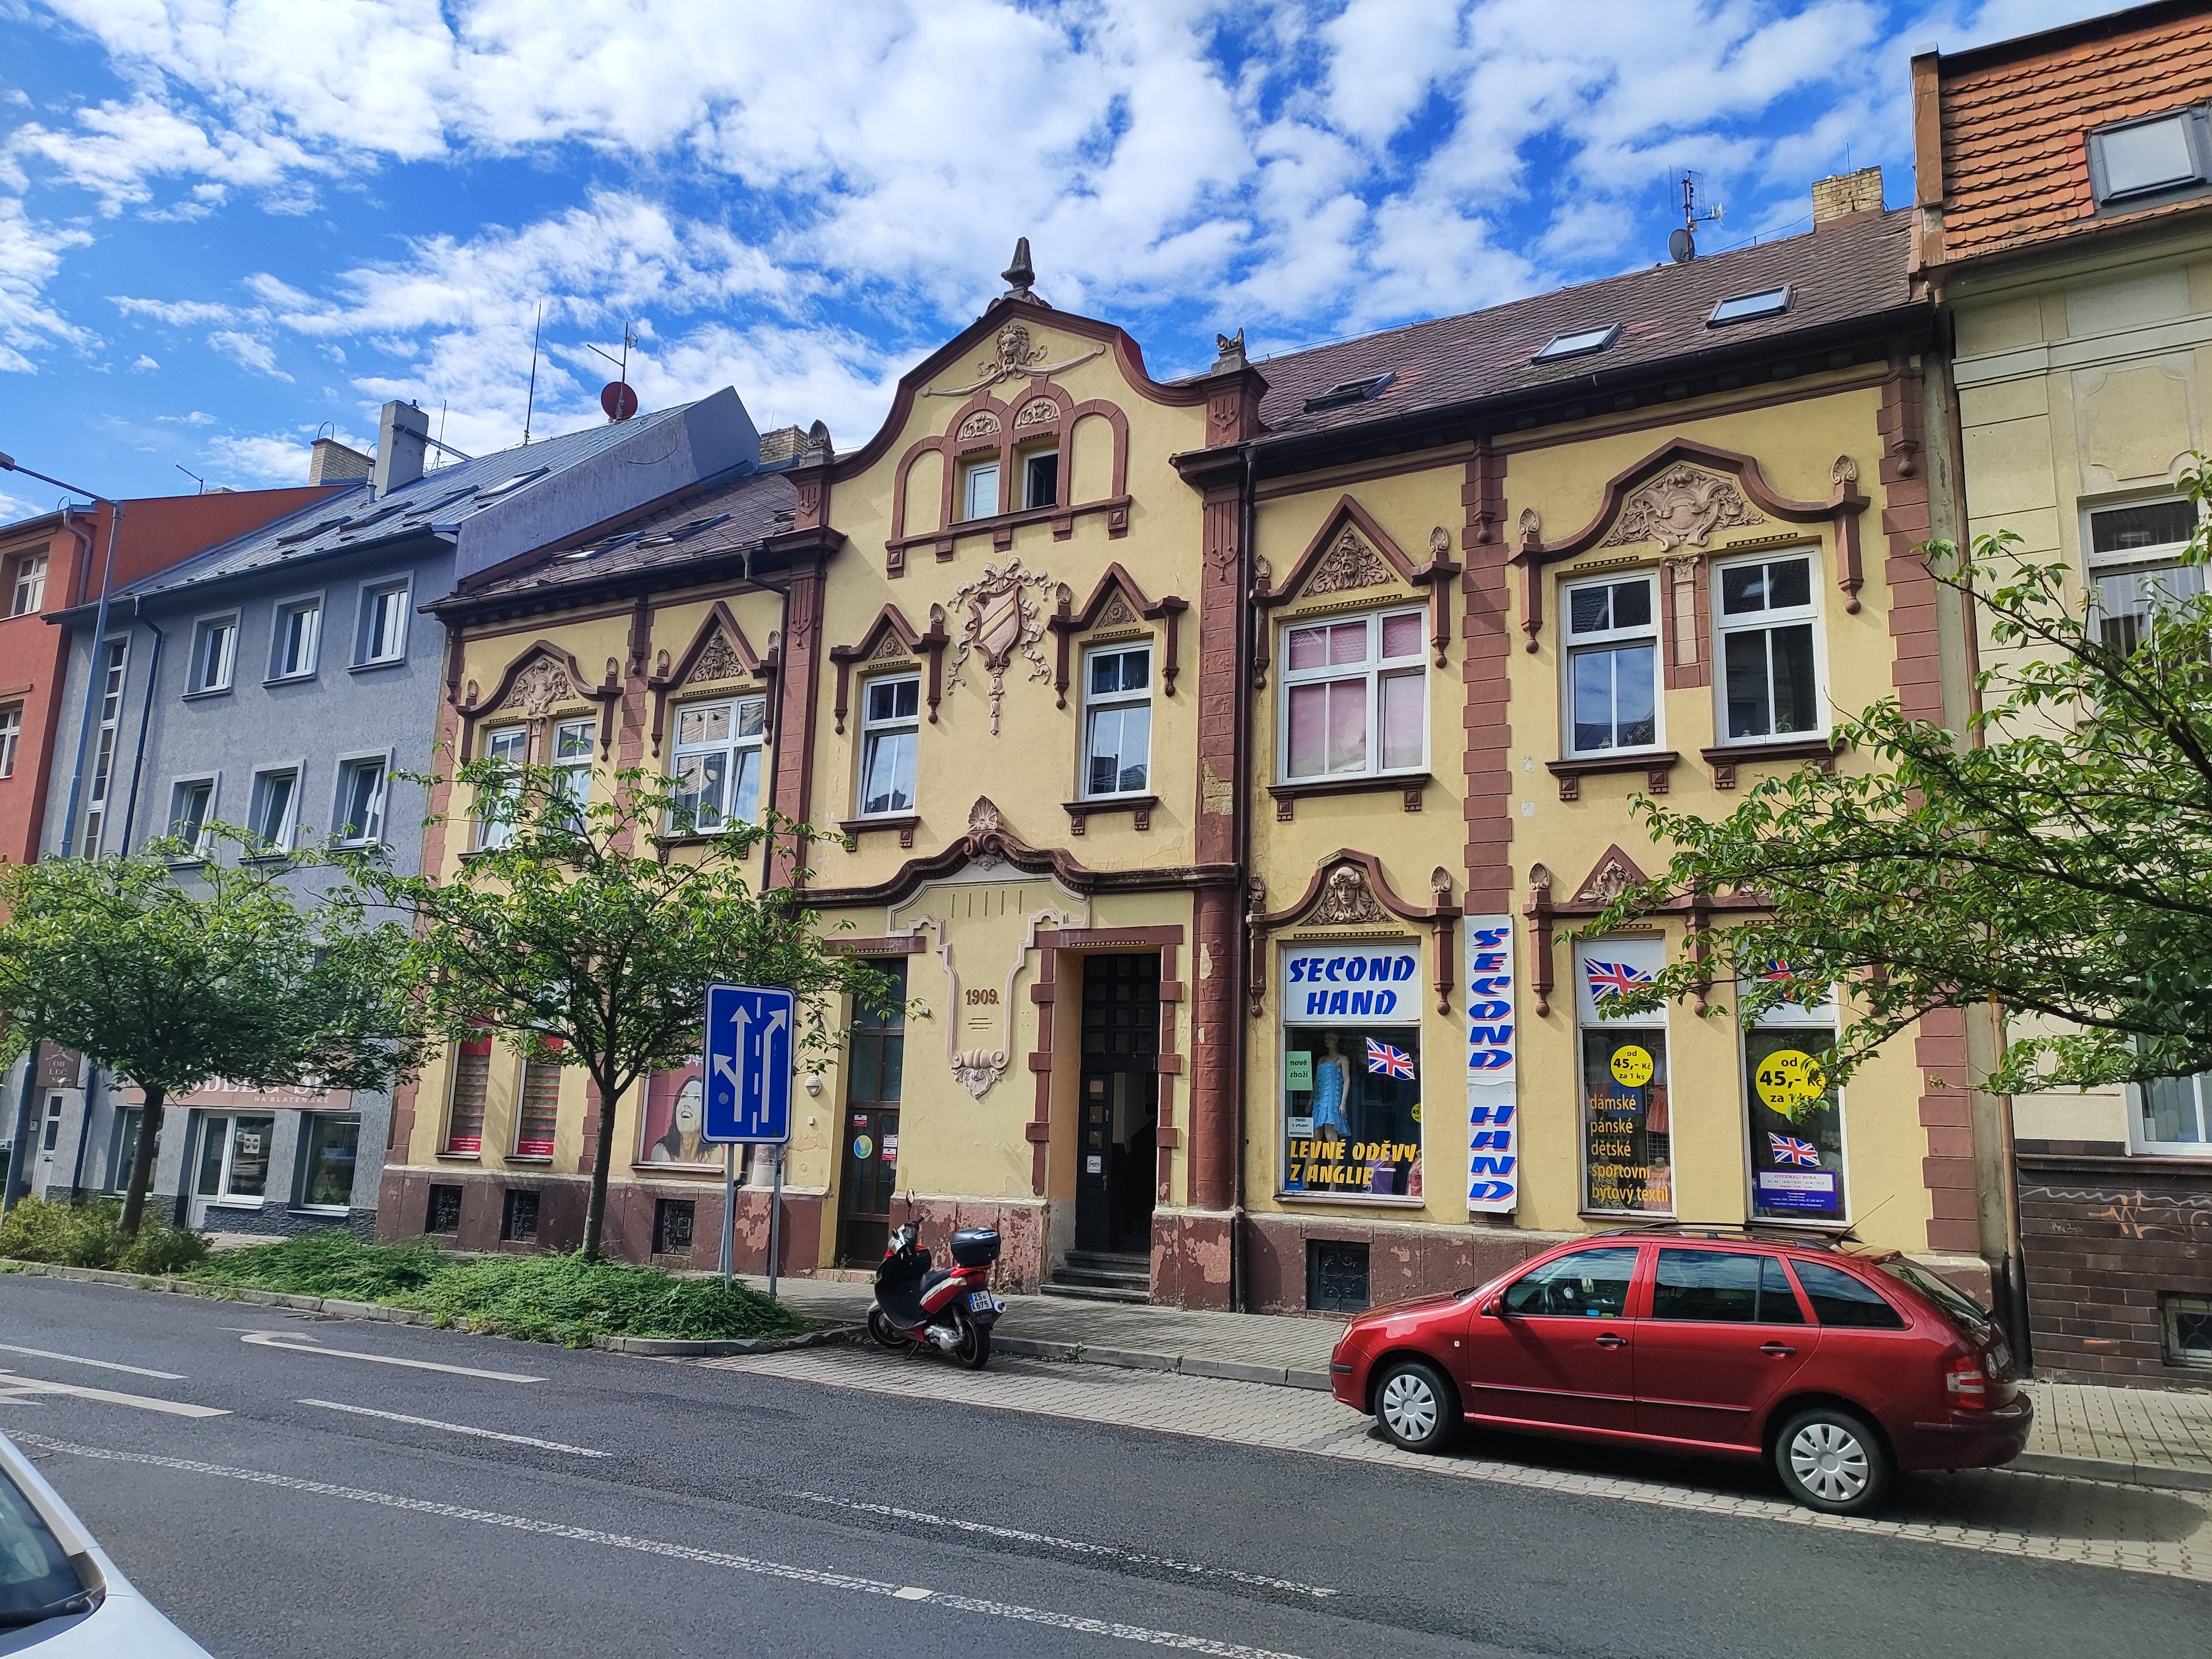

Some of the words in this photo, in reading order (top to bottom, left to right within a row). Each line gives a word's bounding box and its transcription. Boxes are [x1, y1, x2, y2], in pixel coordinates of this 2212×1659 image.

[1288, 955, 1416, 982] SECOND
[966, 989, 999, 1005] 1909.
[1306, 989, 1397, 1015] HAND
[1469, 928, 1515, 1070] SECOND
[1614, 1058, 1639, 1070] 45,-
[1781, 1057, 1798, 1067] od
[1759, 1071, 1802, 1088] 45,-
[1590, 1093, 1636, 1110] dámské
[1590, 1117, 1634, 1136] pánské
[1290, 1139, 1346, 1160] LEVNÉ
[1352, 1140, 1417, 1162] ODĚVY
[1469, 1105, 1516, 1202] HAND
[1591, 1139, 1631, 1157] dětské
[1290, 1164, 1301, 1181] Z
[1306, 1165, 1374, 1185] ANGLIE
[1592, 1182, 1634, 1204] bytový
[1636, 1186, 1668, 1203] textil
